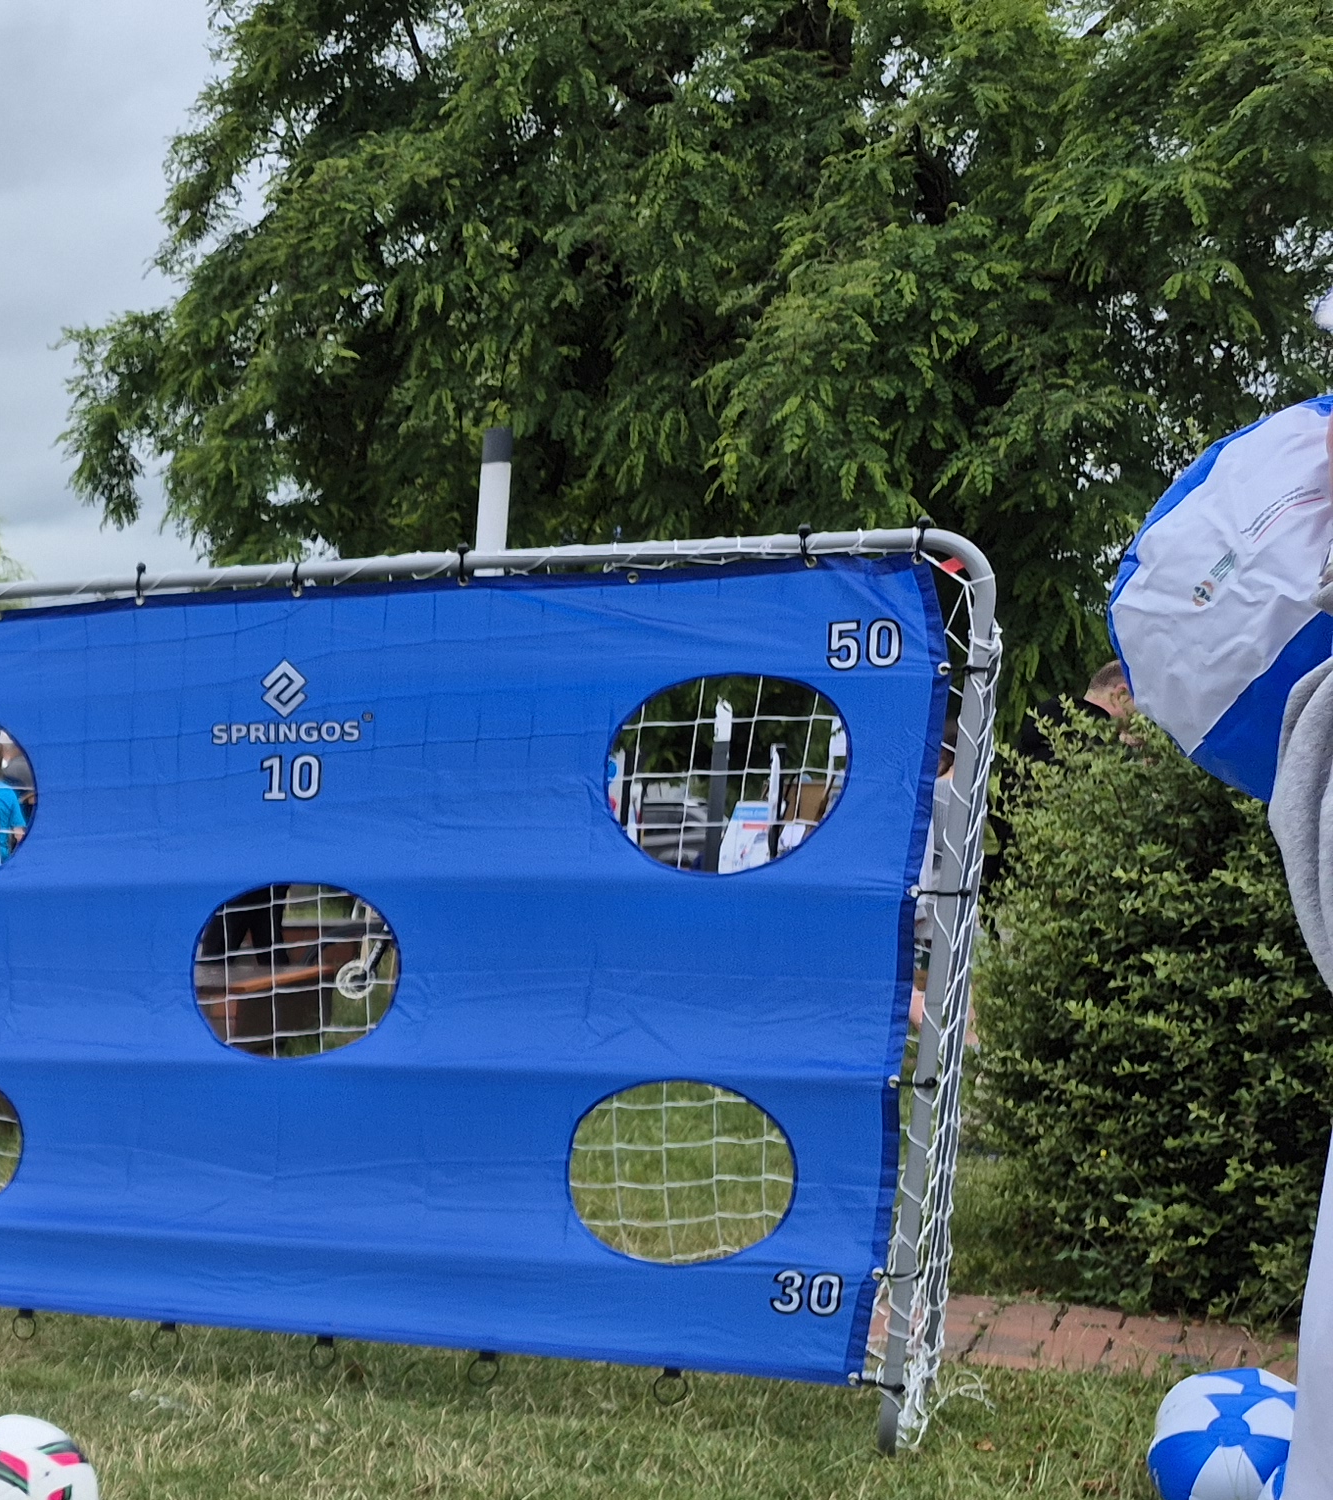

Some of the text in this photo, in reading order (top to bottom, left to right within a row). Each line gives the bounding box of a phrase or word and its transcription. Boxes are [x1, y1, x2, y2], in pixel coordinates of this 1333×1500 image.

[826, 618, 902, 671] 50
[260, 753, 322, 801] 10
[770, 1269, 843, 1317] 30
